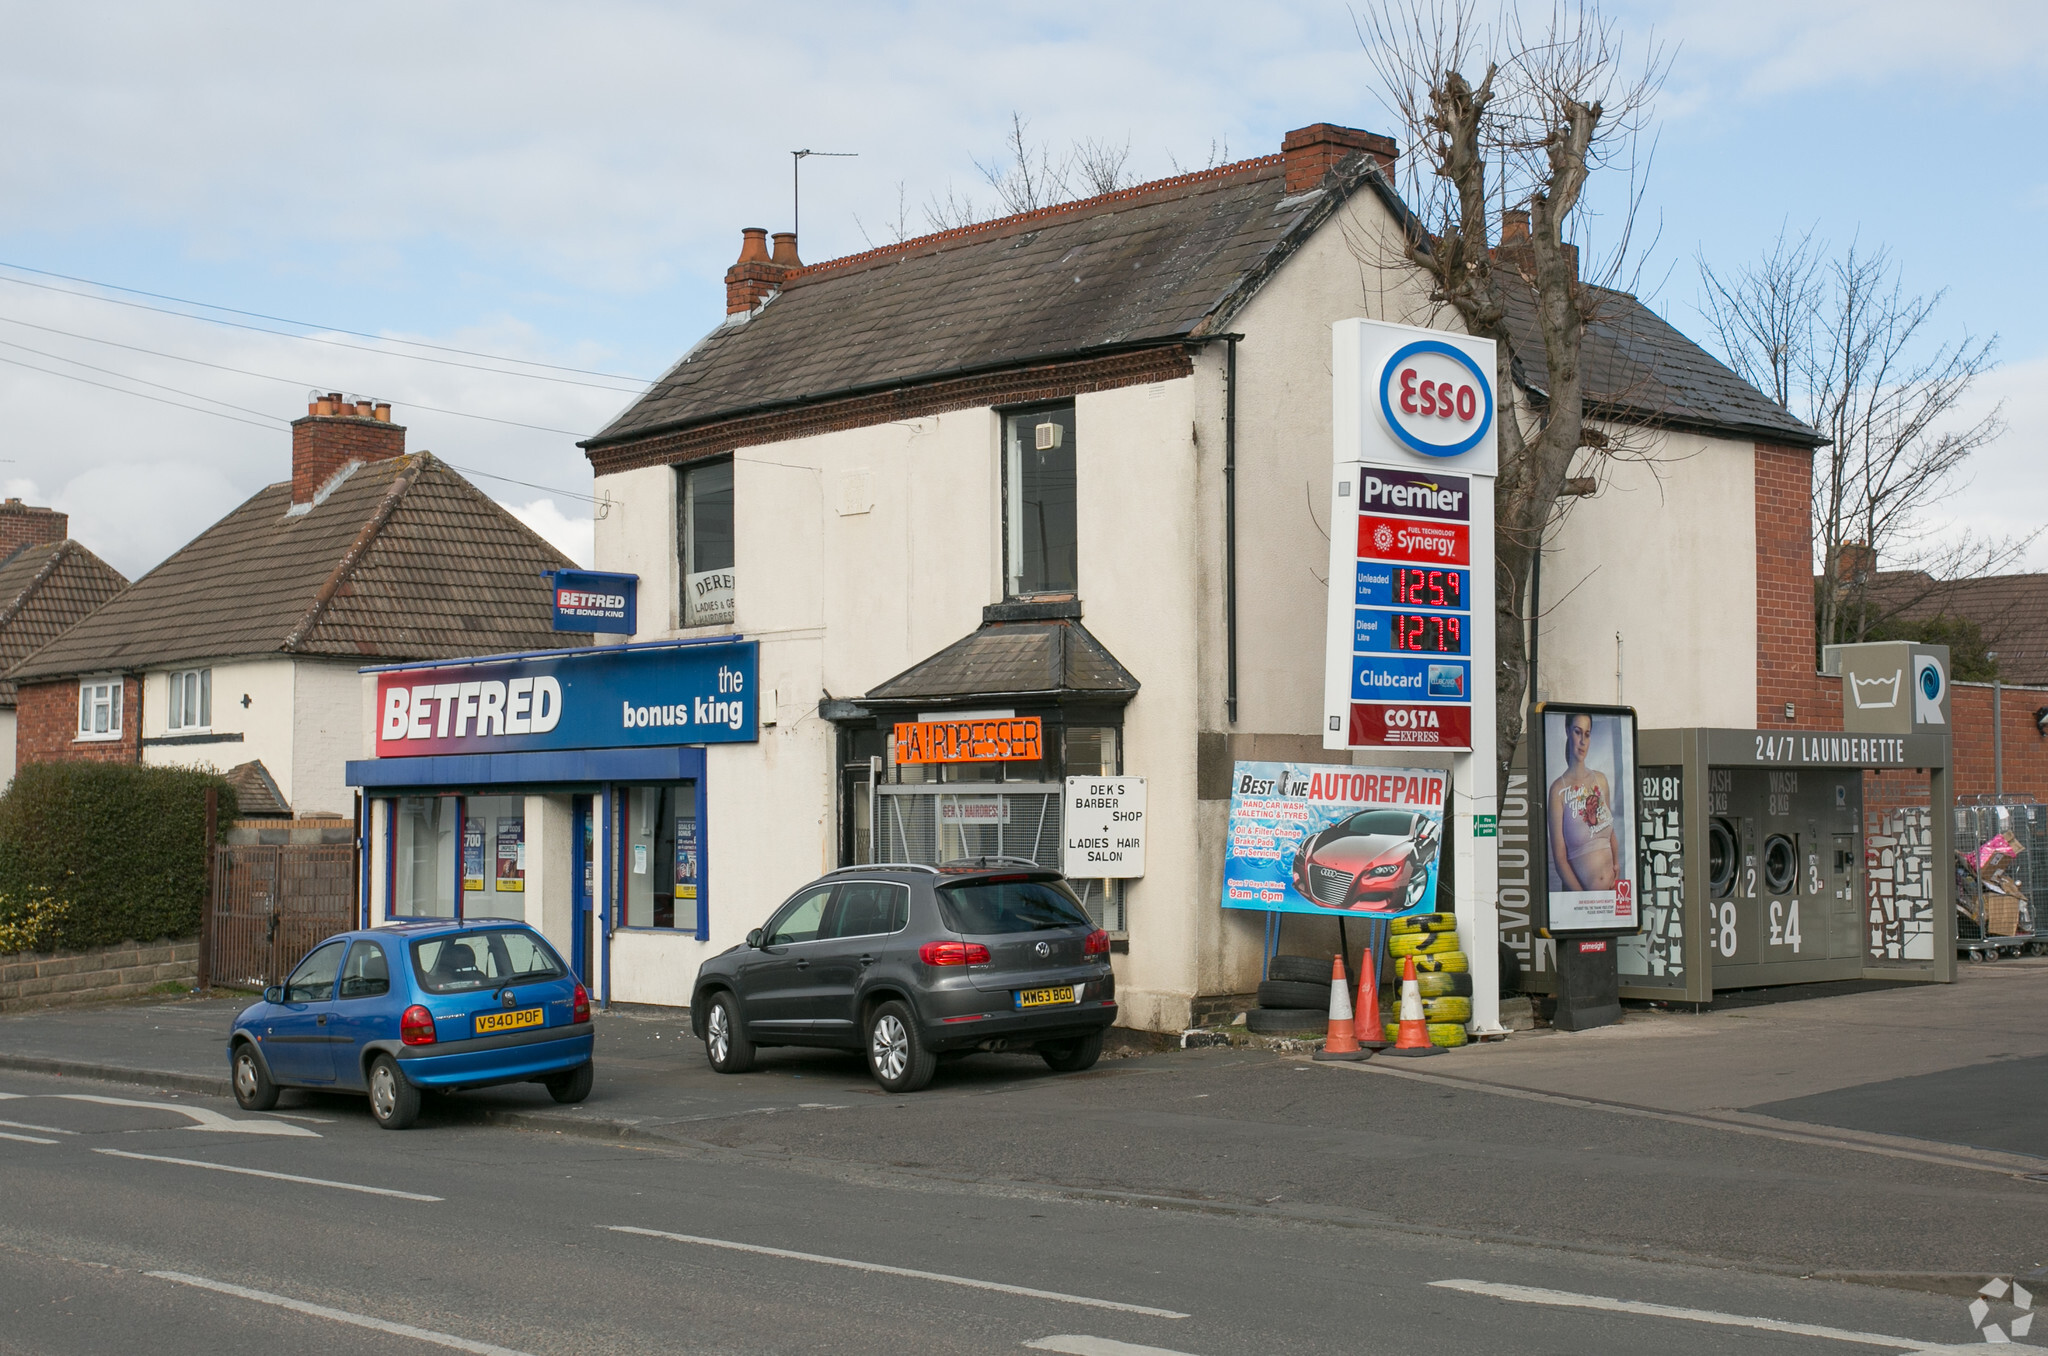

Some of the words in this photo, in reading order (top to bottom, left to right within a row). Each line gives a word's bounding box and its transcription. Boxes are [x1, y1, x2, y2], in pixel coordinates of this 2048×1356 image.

[1365, 476, 1463, 511] Premier
[1408, 526, 1421, 534] FUEL
[1422, 528, 1456, 537] TECHNOLOGY
[1397, 530, 1456, 557] Synergy
[1358, 572, 1390, 584] Unleaded
[1358, 586, 1372, 595] Litre
[1400, 568, 1460, 606] 125.9
[559, 591, 625, 609] BETFRED
[695, 600, 719, 613] LADIES
[720, 601, 725, 609] &
[726, 598, 735, 608] GE
[560, 607, 575, 616] THE
[576, 608, 604, 618] BONUS
[605, 610, 625, 618] KING
[1356, 620, 1378, 631] Diesel
[1357, 633, 1370, 641] Litre
[1399, 615, 1460, 651] 127.9
[718, 665, 744, 693] the
[1360, 669, 1422, 688] Clubcard
[381, 675, 563, 741] BETFRED
[623, 701, 687, 728] bonus
[694, 696, 743, 729] king
[1384, 709, 1440, 730] COSTA
[896, 720, 1039, 760] HAIRDRESSER
[1401, 730, 1440, 743] EXPRESS
[1755, 735, 1795, 761] 24/7
[1802, 737, 1904, 763] LAUNDERETTE
[1308, 772, 1443, 806] AUTOREPAIR
[1769, 771, 1798, 793] WASH
[1090, 784, 1125, 795] DEK'S
[1076, 798, 1119, 808] BARBER
[1243, 801, 1264, 809] HAND
[1716, 793, 1728, 811] KG
[1769, 794, 1777, 816] 8
[1778, 794, 1790, 812] KG
[965, 804, 1008, 818] HAIRDRESSR
[1112, 811, 1143, 822] SHOP
[1237, 809, 1274, 818] VALETING
[1283, 812, 1308, 820] TYRES
[464, 834, 480, 847] 700
[1254, 828, 1273, 836] Filter
[1274, 829, 1301, 839] Change
[1069, 838, 1109, 848] LADIES
[1117, 838, 1140, 848] HAIR
[1235, 837, 1255, 845] Brake
[1087, 851, 1123, 861] SALON
[1233, 847, 1247, 855] Car
[1248, 849, 1280, 858] Servicing
[1228, 879, 1243, 887] Open
[1747, 869, 1756, 898] 2
[1809, 866, 1819, 895] 3
[1230, 888, 1252, 898] 9am
[1261, 890, 1284, 902] 6pm
[1769, 900, 1802, 954] £4
[1581, 941, 1605, 952] primesight
[1022, 989, 1051, 1005] MW63
[1053, 987, 1072, 1001] BGO
[478, 1013, 513, 1030] V940
[516, 1009, 541, 1024] POF
